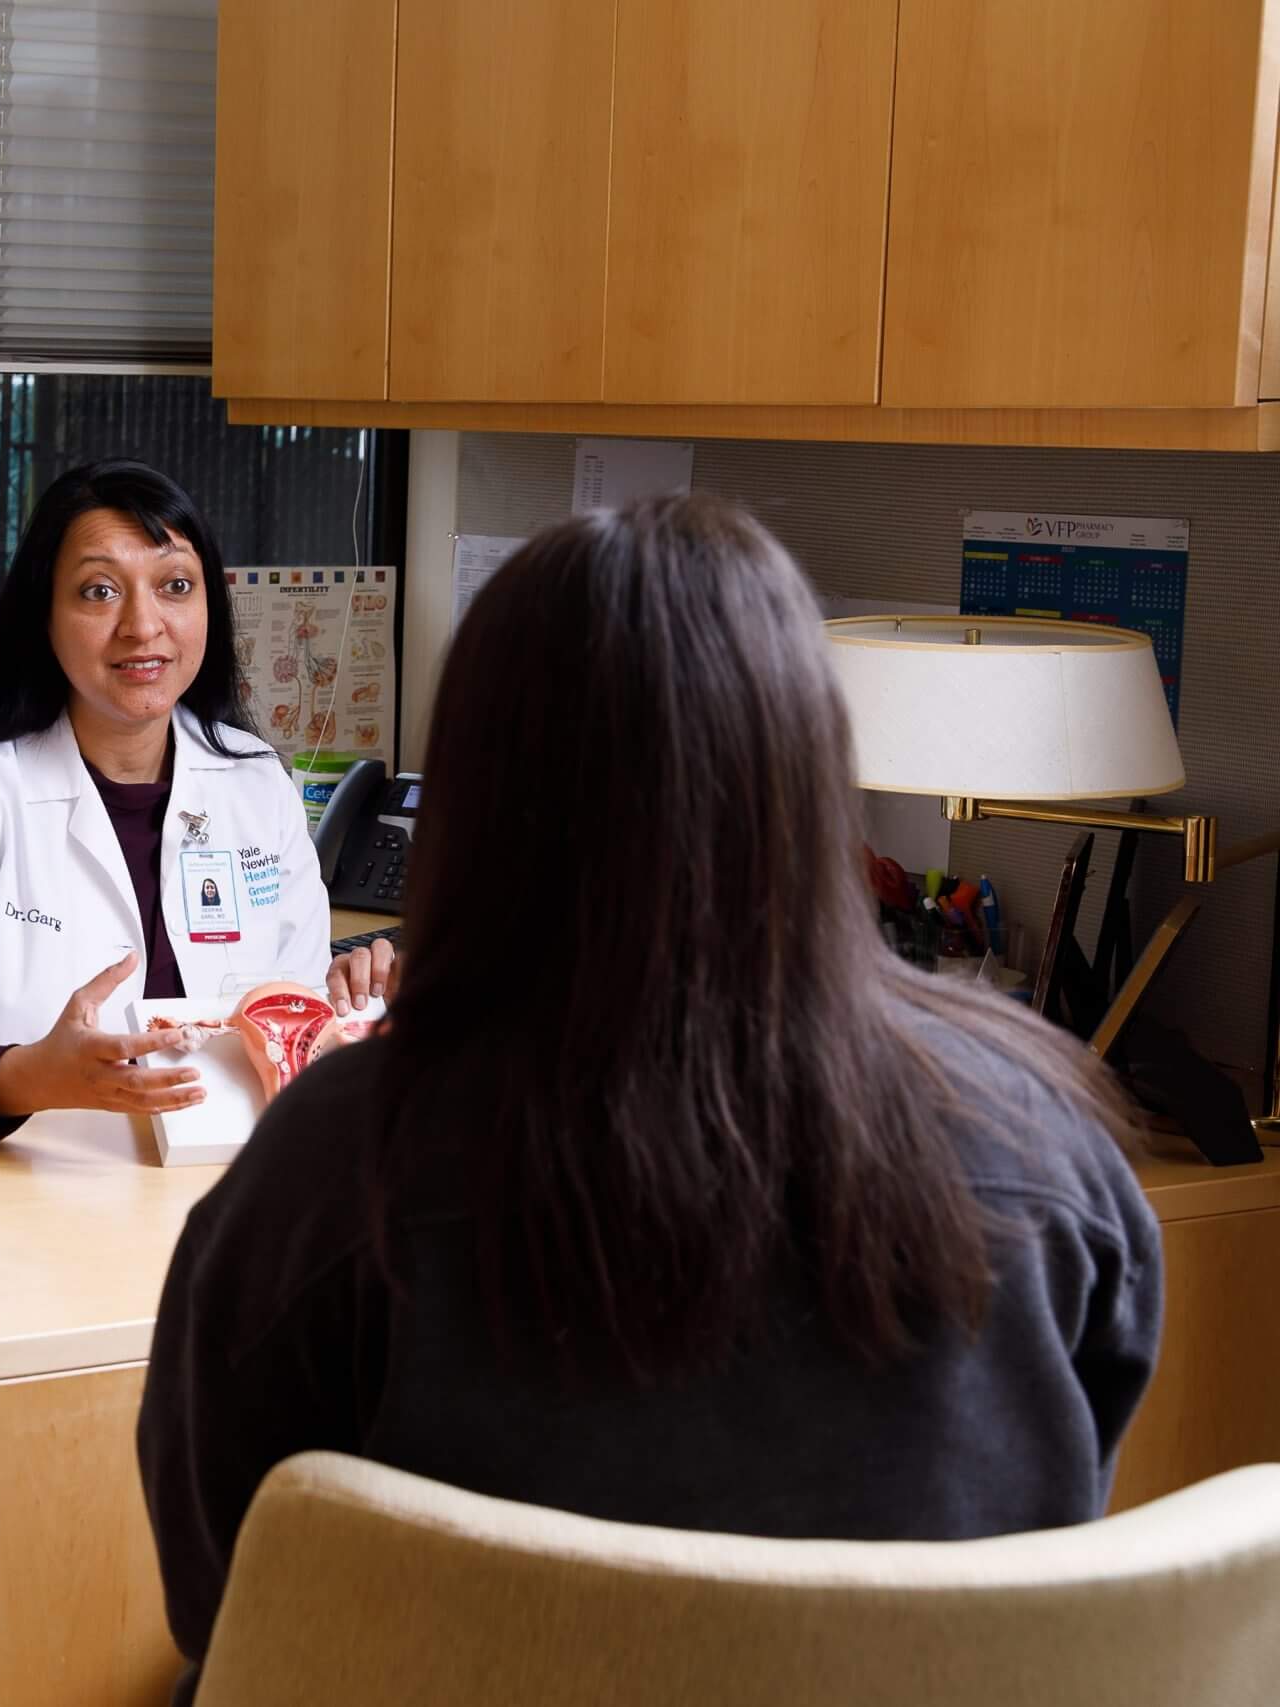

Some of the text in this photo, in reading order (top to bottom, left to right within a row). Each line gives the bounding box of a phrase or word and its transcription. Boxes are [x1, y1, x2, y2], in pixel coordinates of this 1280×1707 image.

[1045, 520, 1076, 537] VFP
[306, 787, 334, 799] Ceta
[236, 846, 261, 860] Yale
